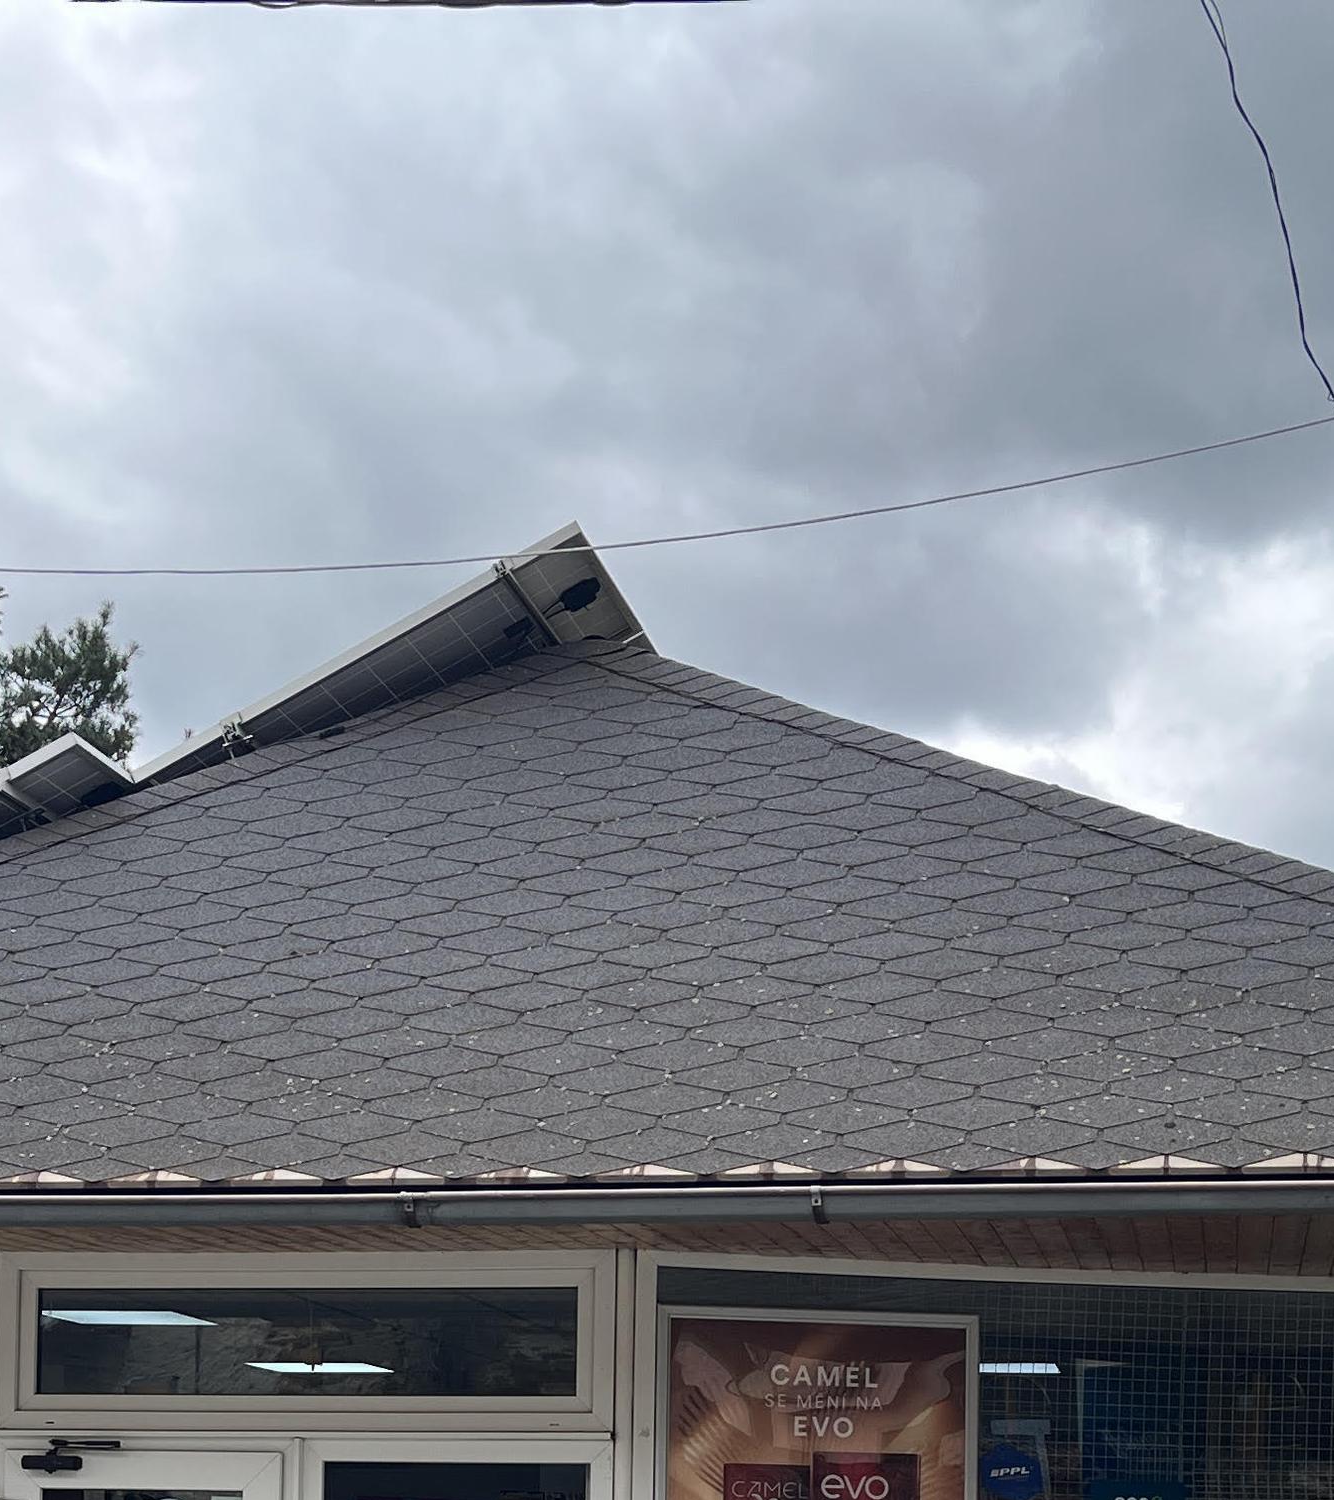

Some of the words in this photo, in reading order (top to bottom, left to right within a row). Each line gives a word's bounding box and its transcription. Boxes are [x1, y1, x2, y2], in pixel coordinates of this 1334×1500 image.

[770, 1363, 879, 1389] CAMEL
[764, 1393, 787, 1408] SE
[856, 1396, 883, 1411] NA
[793, 1415, 854, 1438] EVO
[998, 1466, 1031, 1476] PPL
[731, 1480, 809, 1499] CAMEL
[820, 1474, 890, 1500] evo
